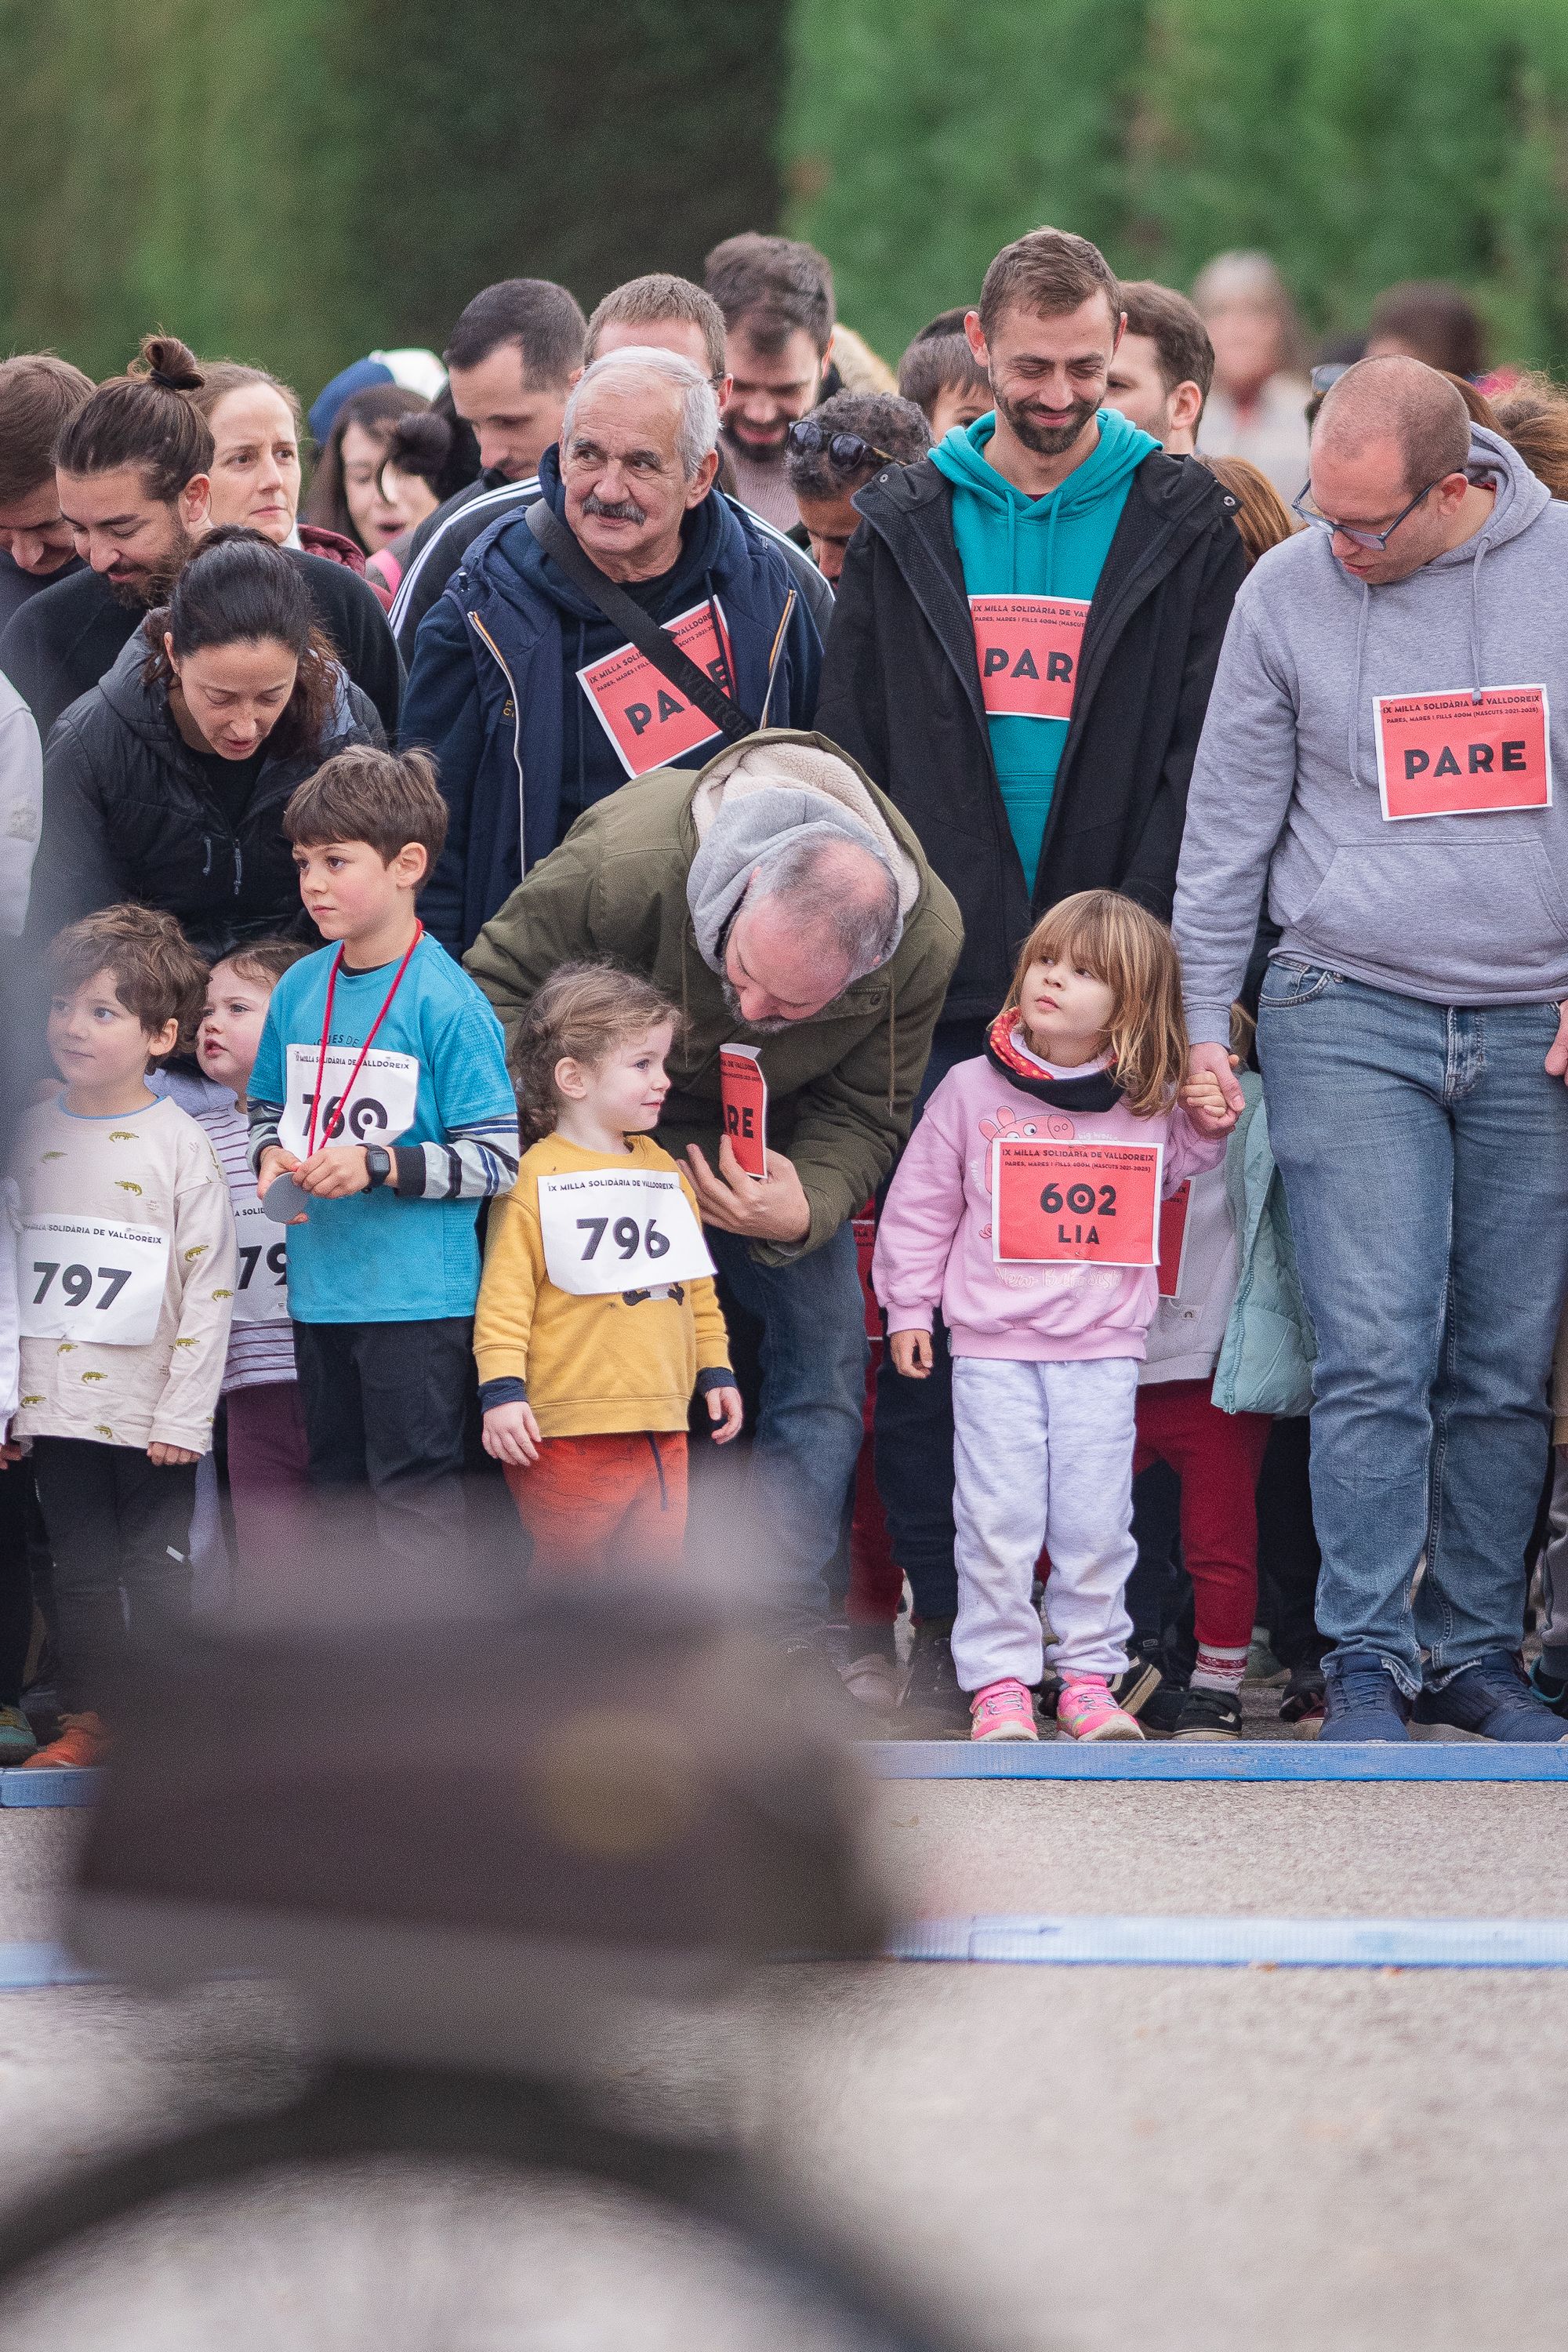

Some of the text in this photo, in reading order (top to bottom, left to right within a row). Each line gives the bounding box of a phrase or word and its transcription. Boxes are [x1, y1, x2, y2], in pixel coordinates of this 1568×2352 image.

[1011, 604, 1056, 615] SOLIDÀRIA
[589, 673, 599, 684] IX
[599, 663, 622, 679] MILLA
[983, 648, 1073, 684] PAR
[623, 657, 729, 735] PAE
[1395, 705, 1421, 713] MILLA
[1423, 700, 1469, 710] SOLIDÀRIA
[1486, 695, 1541, 705] VALLDOREIX
[1403, 740, 1527, 780] PARE
[315, 1056, 346, 1065] SLIDÀRIA
[360, 1058, 409, 1070] ALLDOREIX
[302, 1093, 388, 1141] 760
[724, 1104, 754, 1139] RE
[1104, 1152, 1155, 1162] VALLDOREIX
[560, 1182, 586, 1191] MILLA
[588, 1178, 630, 1188] SOLIDÀRIA
[642, 1181, 674, 1190] VALLDOREIX
[1040, 1182, 1116, 1216] 602
[48, 1224, 90, 1234] SOLIDÀRIA
[108, 1229, 162, 1245] VALLDOREIX
[575, 1216, 670, 1261] 796
[1058, 1224, 1100, 1245] LIA
[32, 1261, 132, 1310] 797
